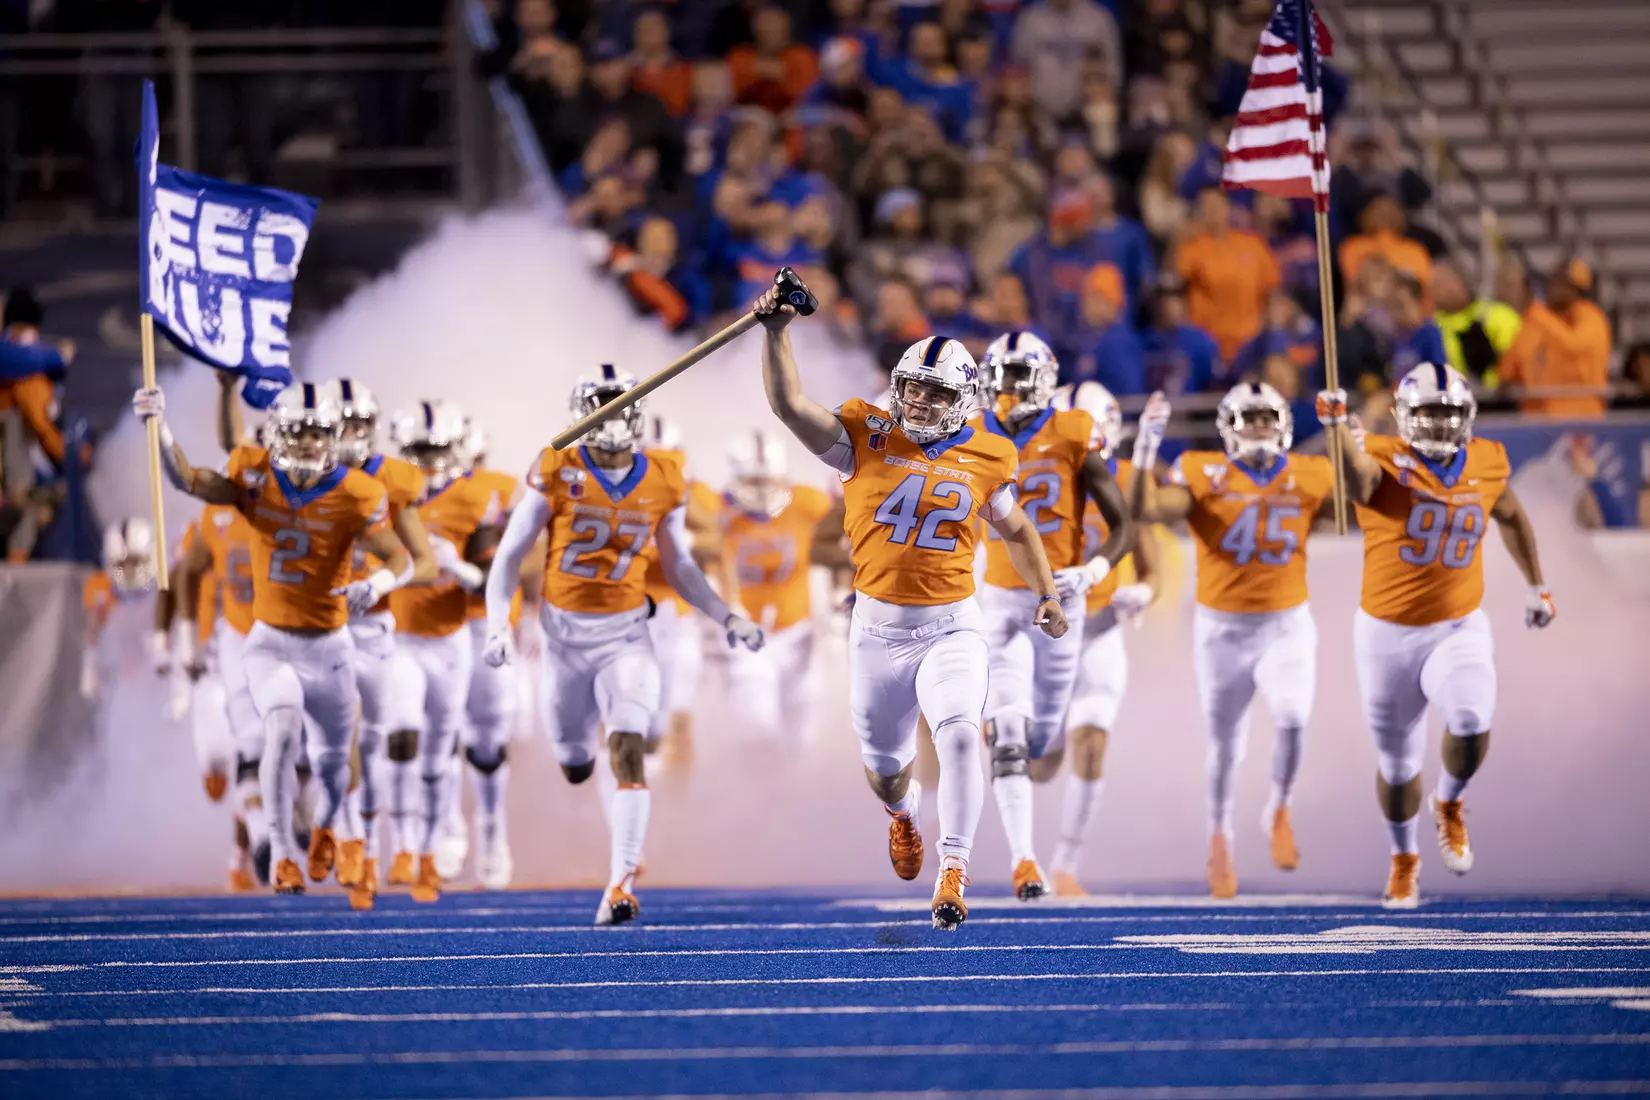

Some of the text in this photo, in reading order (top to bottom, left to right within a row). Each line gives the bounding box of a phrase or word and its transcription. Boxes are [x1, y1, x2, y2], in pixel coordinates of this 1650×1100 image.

[152, 184, 309, 283] EED
[884, 455, 974, 484] BOISE STATE
[873, 473, 973, 552] 42
[1220, 504, 1301, 566] 45
[1398, 501, 1485, 569] 98
[268, 528, 311, 584] 2
[559, 517, 651, 581] 27
